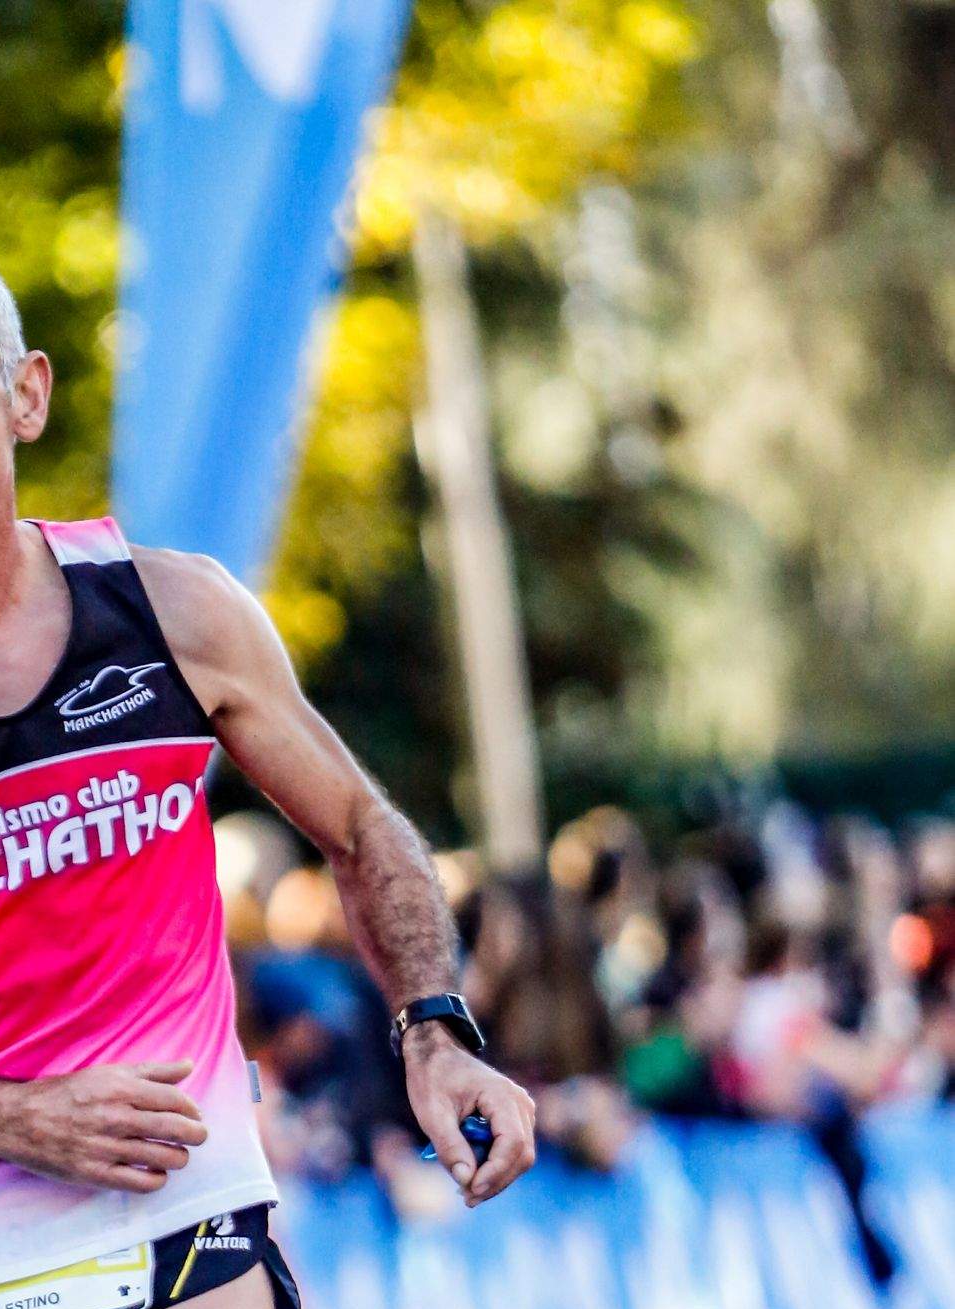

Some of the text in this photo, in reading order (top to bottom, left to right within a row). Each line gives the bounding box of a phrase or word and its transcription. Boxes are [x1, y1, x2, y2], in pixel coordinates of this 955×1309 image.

[63, 687, 156, 733] MANCHATHON
[77, 769, 141, 809] club
[194, 1236, 252, 1251] VIATOR
